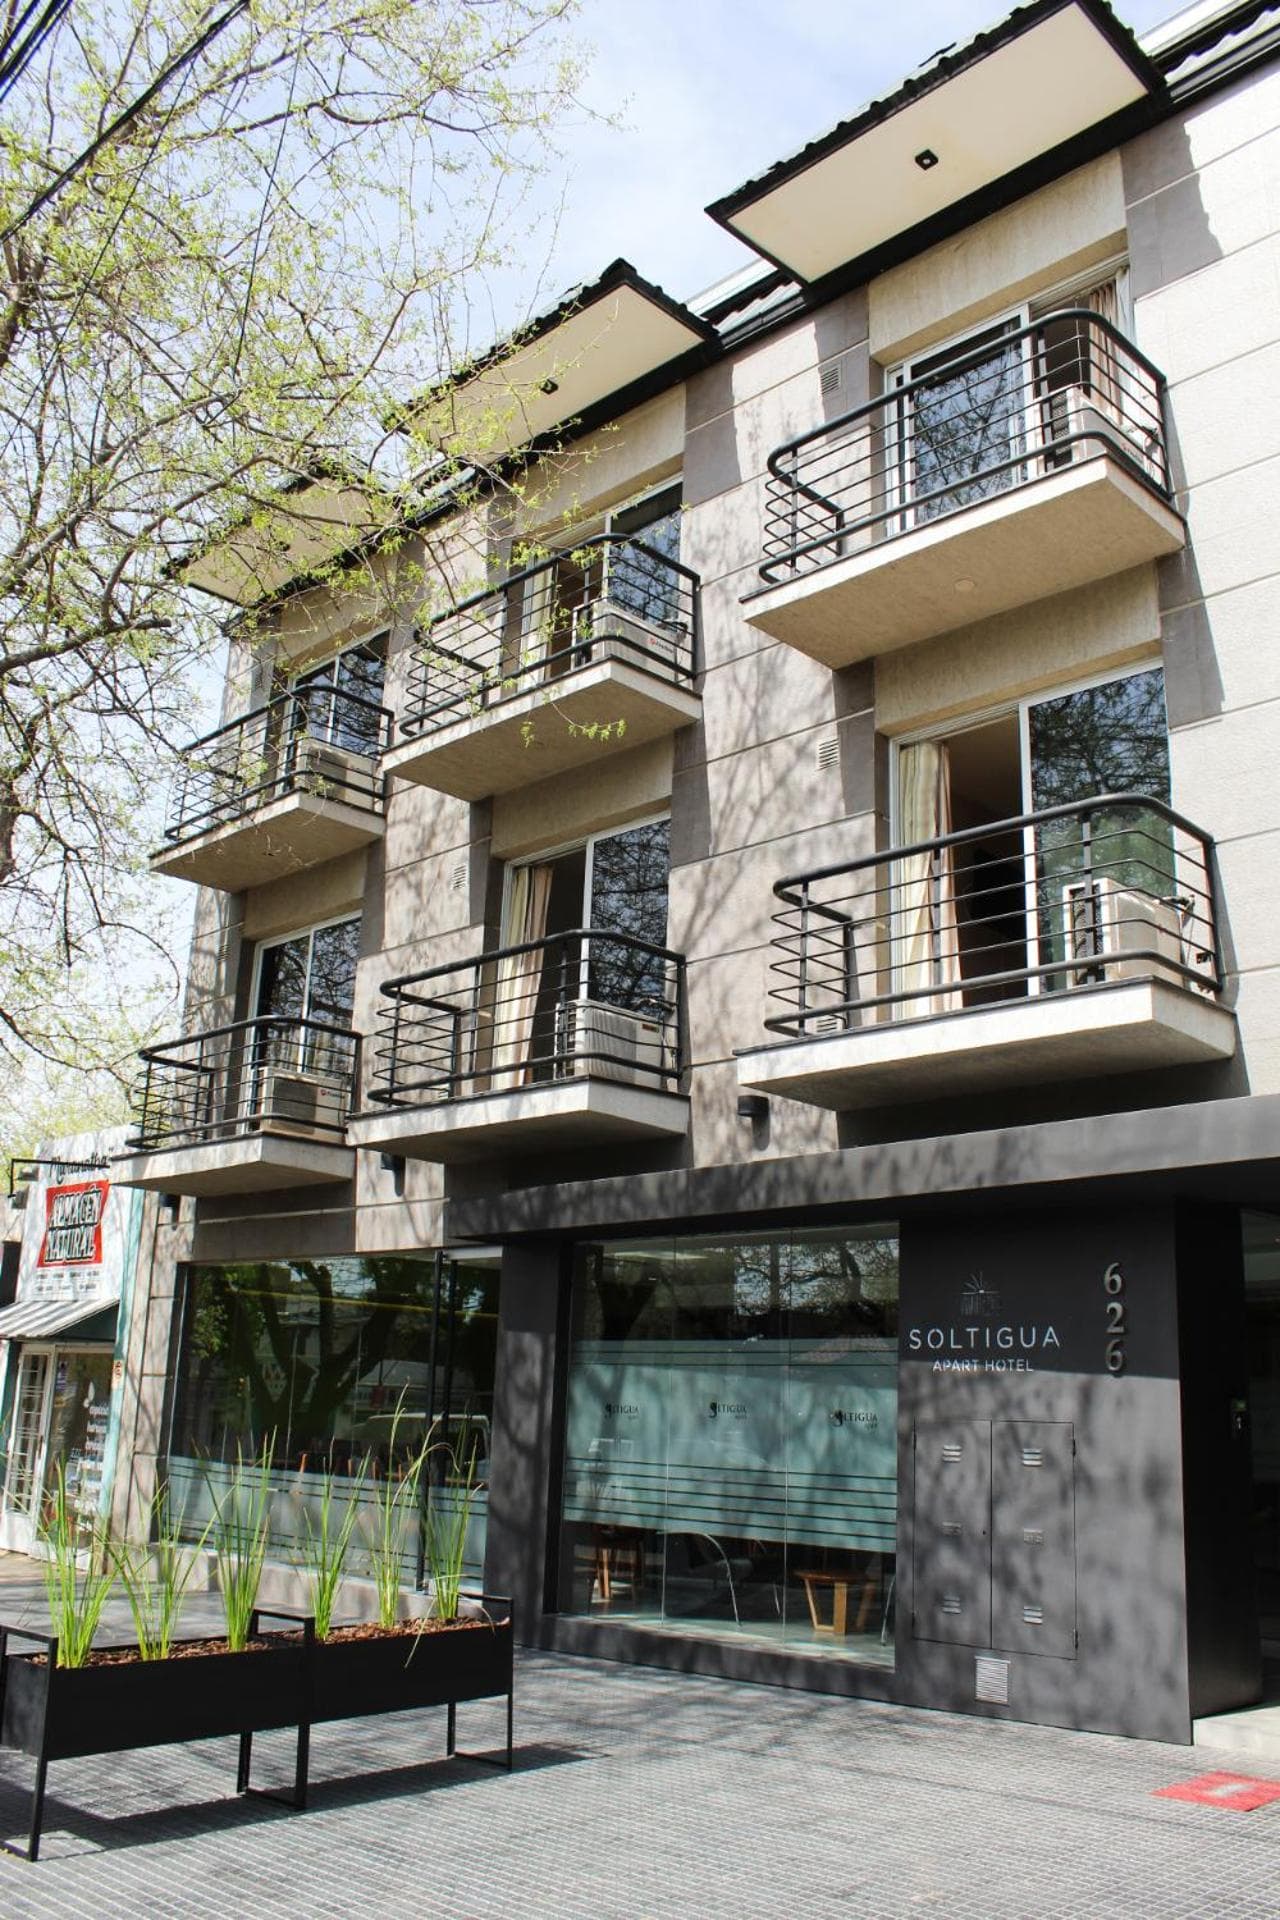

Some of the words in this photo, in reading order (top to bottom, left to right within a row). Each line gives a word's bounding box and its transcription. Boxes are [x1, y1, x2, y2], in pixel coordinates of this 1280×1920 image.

[44, 1228, 95, 1262] NATURAL
[1104, 1262, 1125, 1372] 626
[908, 1325, 1061, 1350] SOLTIGUA
[932, 1358, 980, 1372] APART
[984, 1358, 1035, 1372] HOTEL
